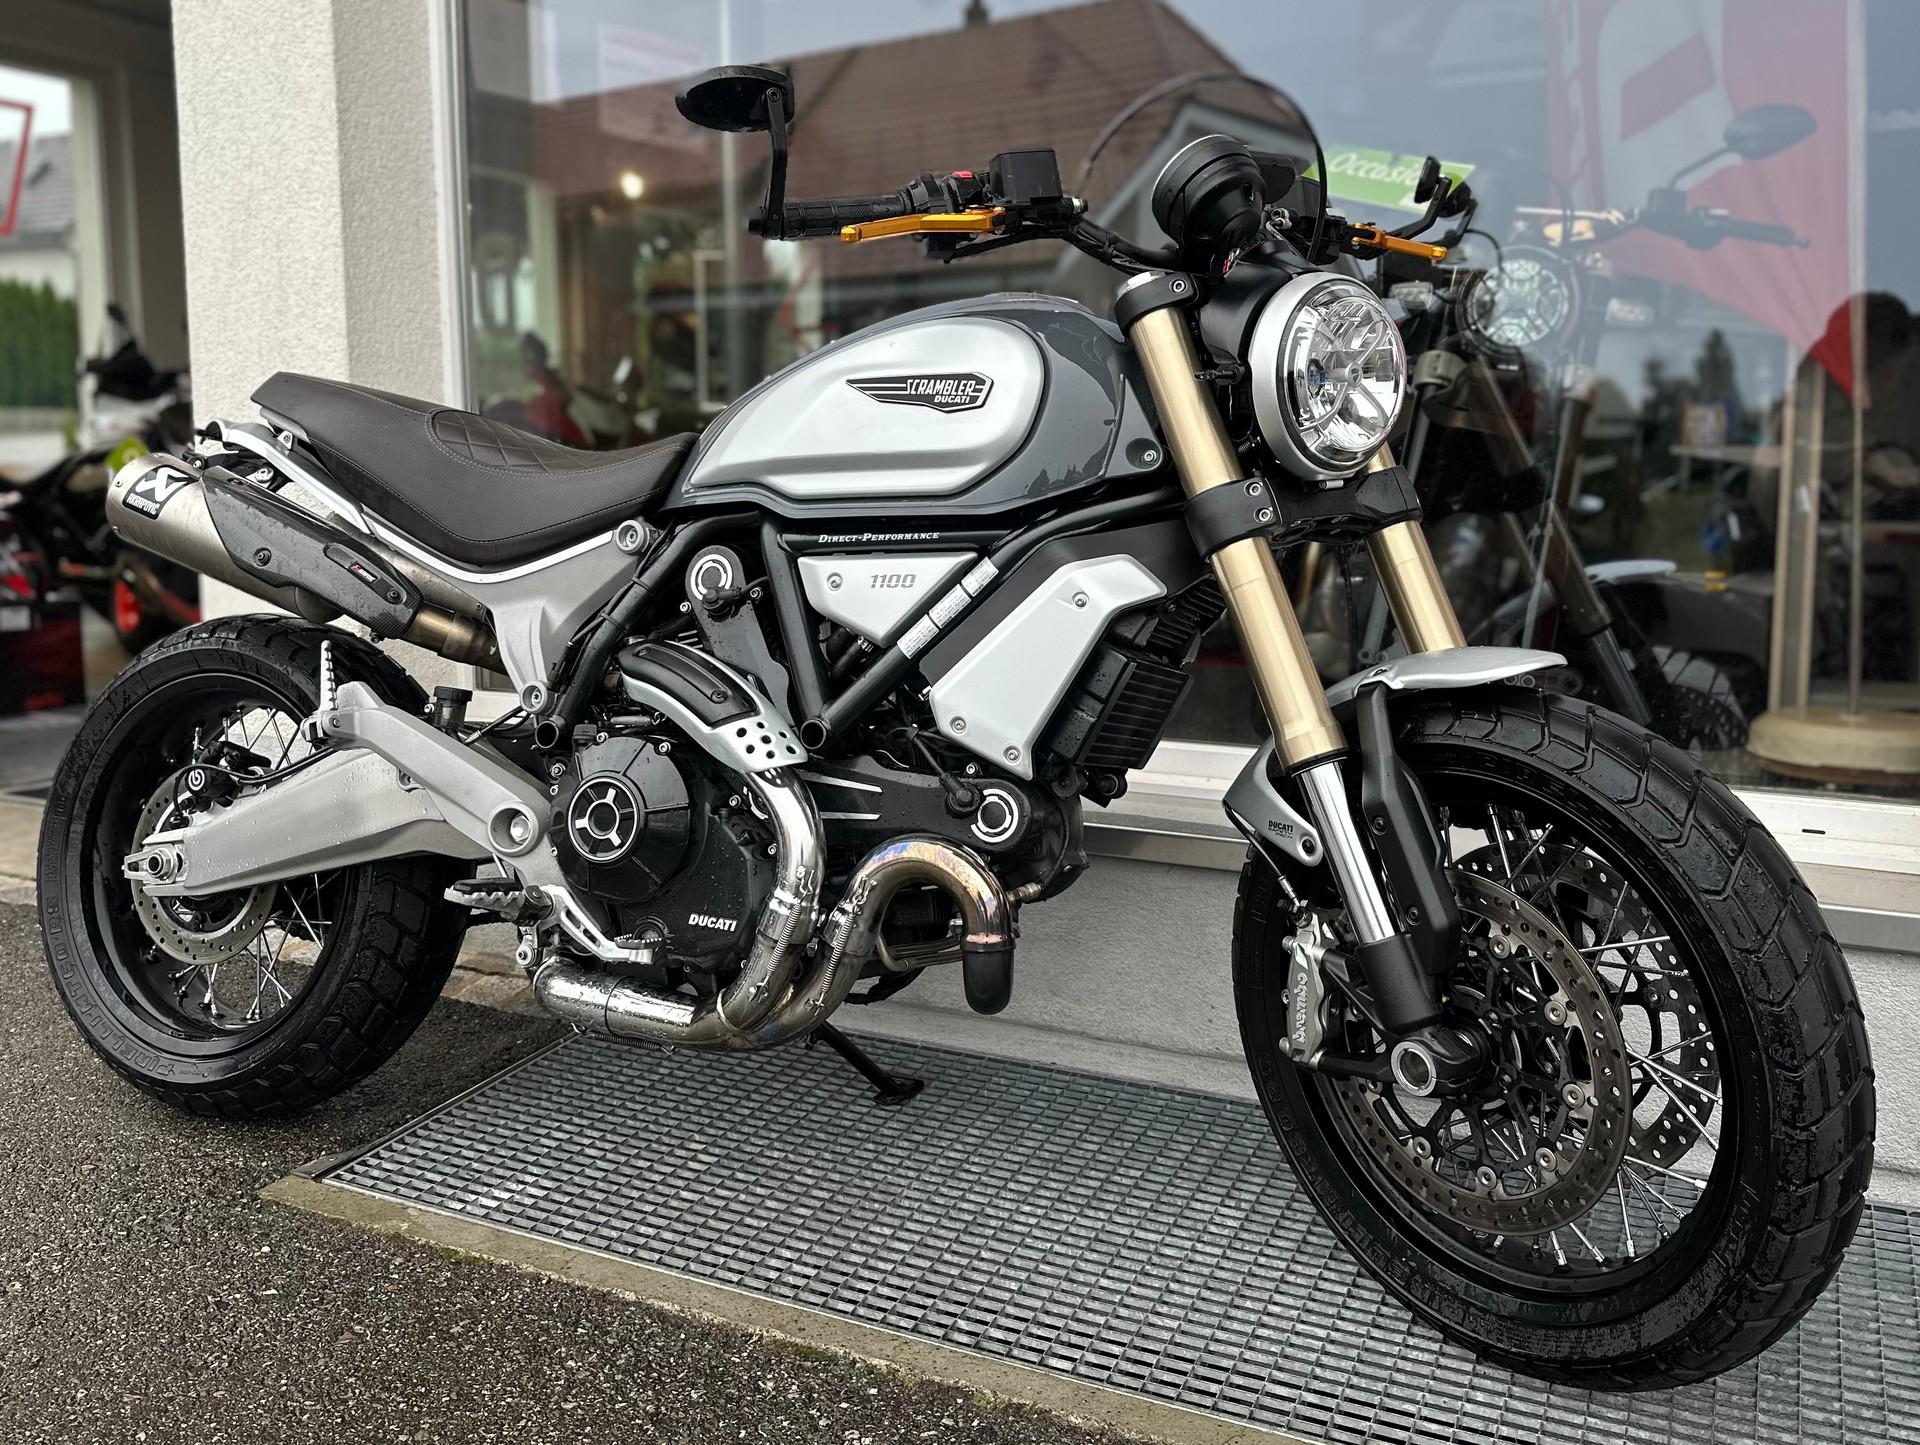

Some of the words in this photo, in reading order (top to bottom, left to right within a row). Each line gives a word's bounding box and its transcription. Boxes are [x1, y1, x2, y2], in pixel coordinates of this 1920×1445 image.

[1329, 152, 1422, 187] Occasio
[906, 379, 976, 396] SCRAMBLER
[934, 395, 970, 404] DUCATI
[870, 574, 917, 589] 1100
[1268, 819, 1294, 832] DUCATI
[688, 913, 737, 932] DUCATI
[1292, 972, 1308, 1043] brembo
[88, 1012, 175, 1078] PIRELLI
